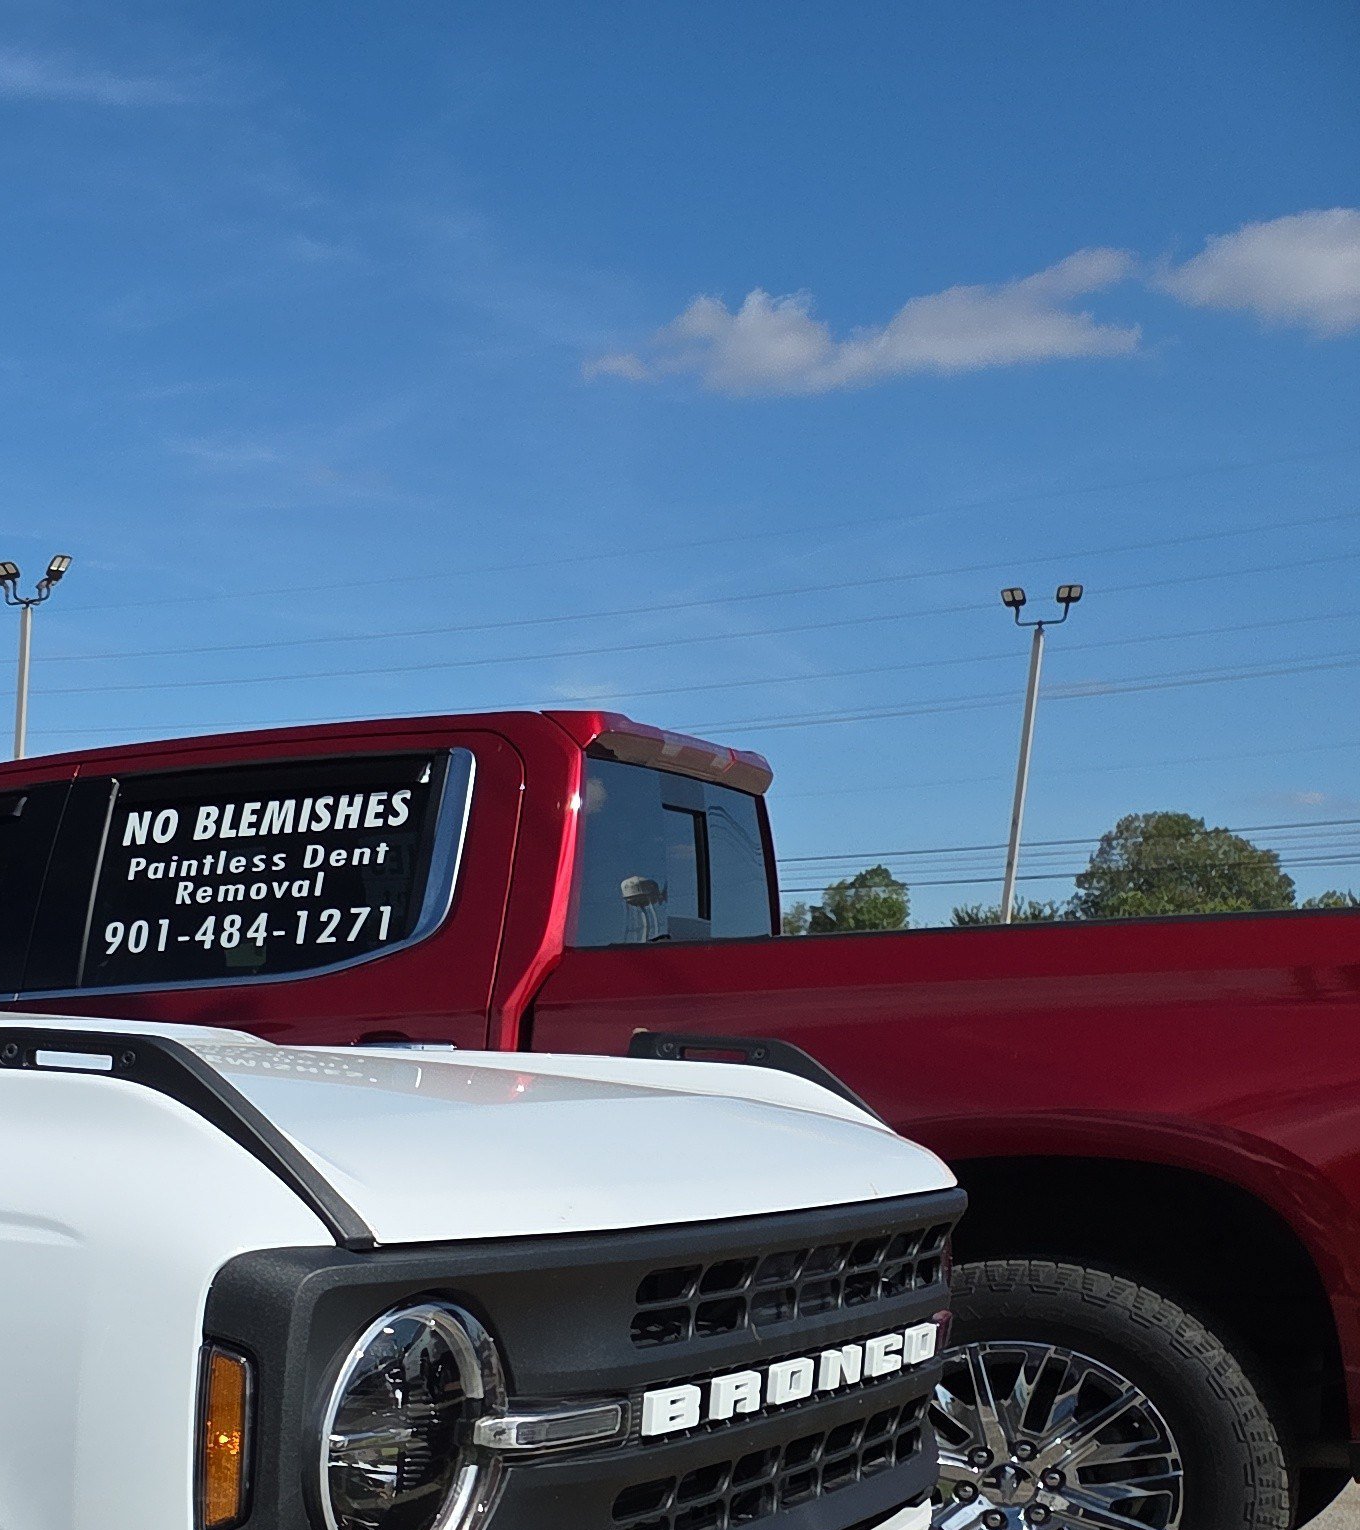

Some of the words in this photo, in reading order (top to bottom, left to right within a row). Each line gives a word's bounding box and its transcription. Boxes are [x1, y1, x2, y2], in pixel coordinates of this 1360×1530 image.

[122, 809, 179, 847] NO
[193, 790, 412, 841] BLEMISHES
[127, 850, 287, 881] Paintless
[302, 842, 390, 870] Dent
[175, 871, 325, 905] Removal
[104, 905, 393, 955] 901-484-1271
[641, 1322, 938, 1436] BRONCO
